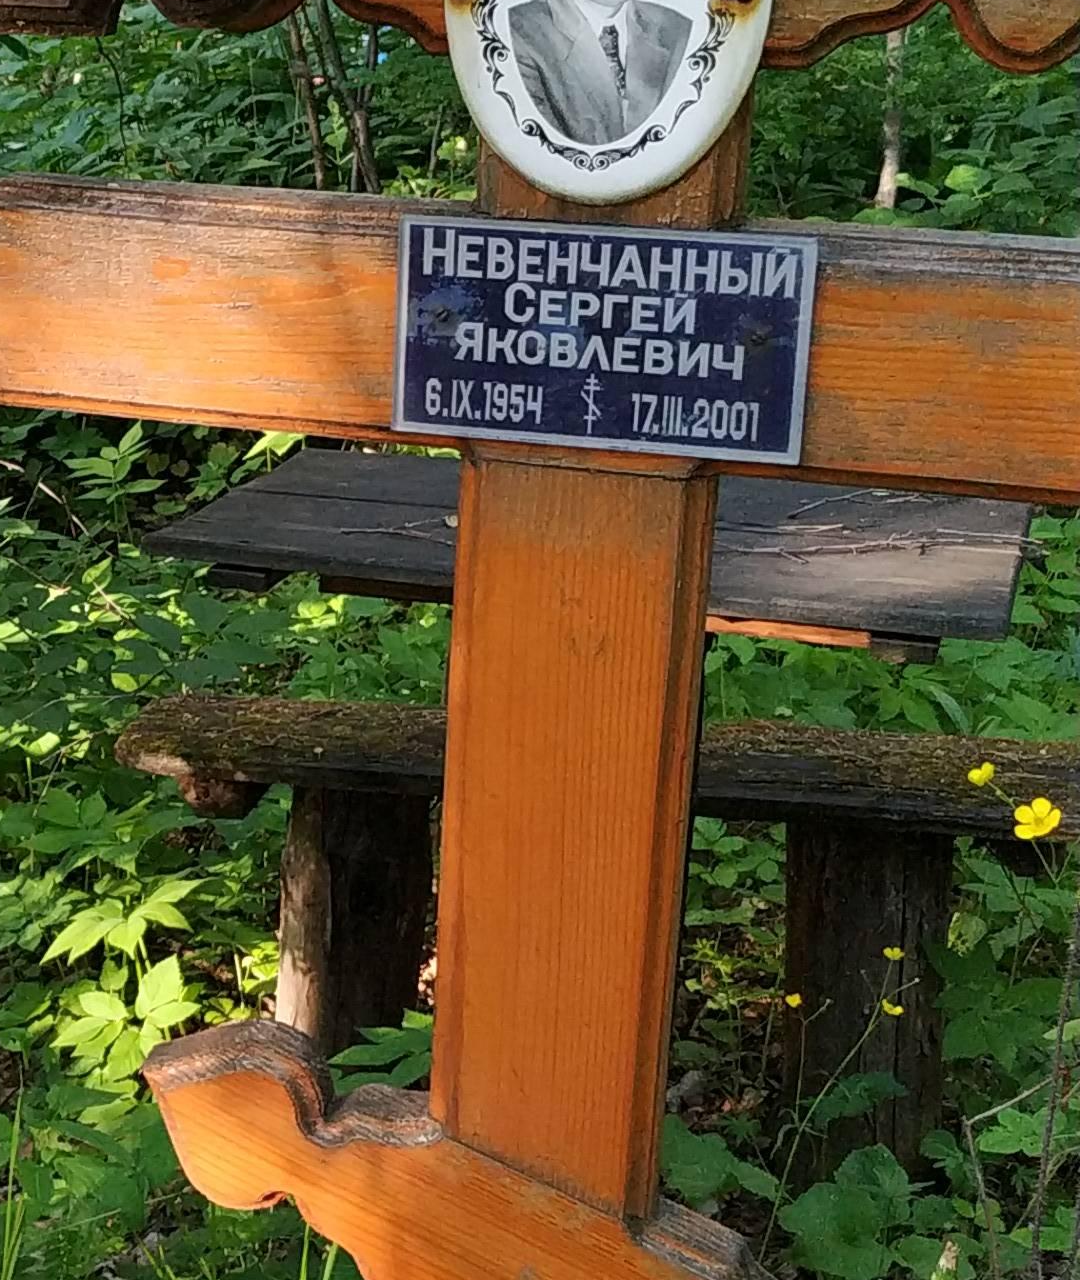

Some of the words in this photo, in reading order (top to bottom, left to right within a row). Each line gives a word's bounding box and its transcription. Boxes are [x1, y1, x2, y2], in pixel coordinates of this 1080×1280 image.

[422, 227, 799, 299] НЕВЕНЧАННЫЙ
[503, 281, 698, 335] СЕРГЕЙ
[453, 321, 746, 381] ЯКОВЛЕВИЧ
[424, 377, 544, 425] 6.IX.1954
[631, 392, 761, 443] 17.III.2001
